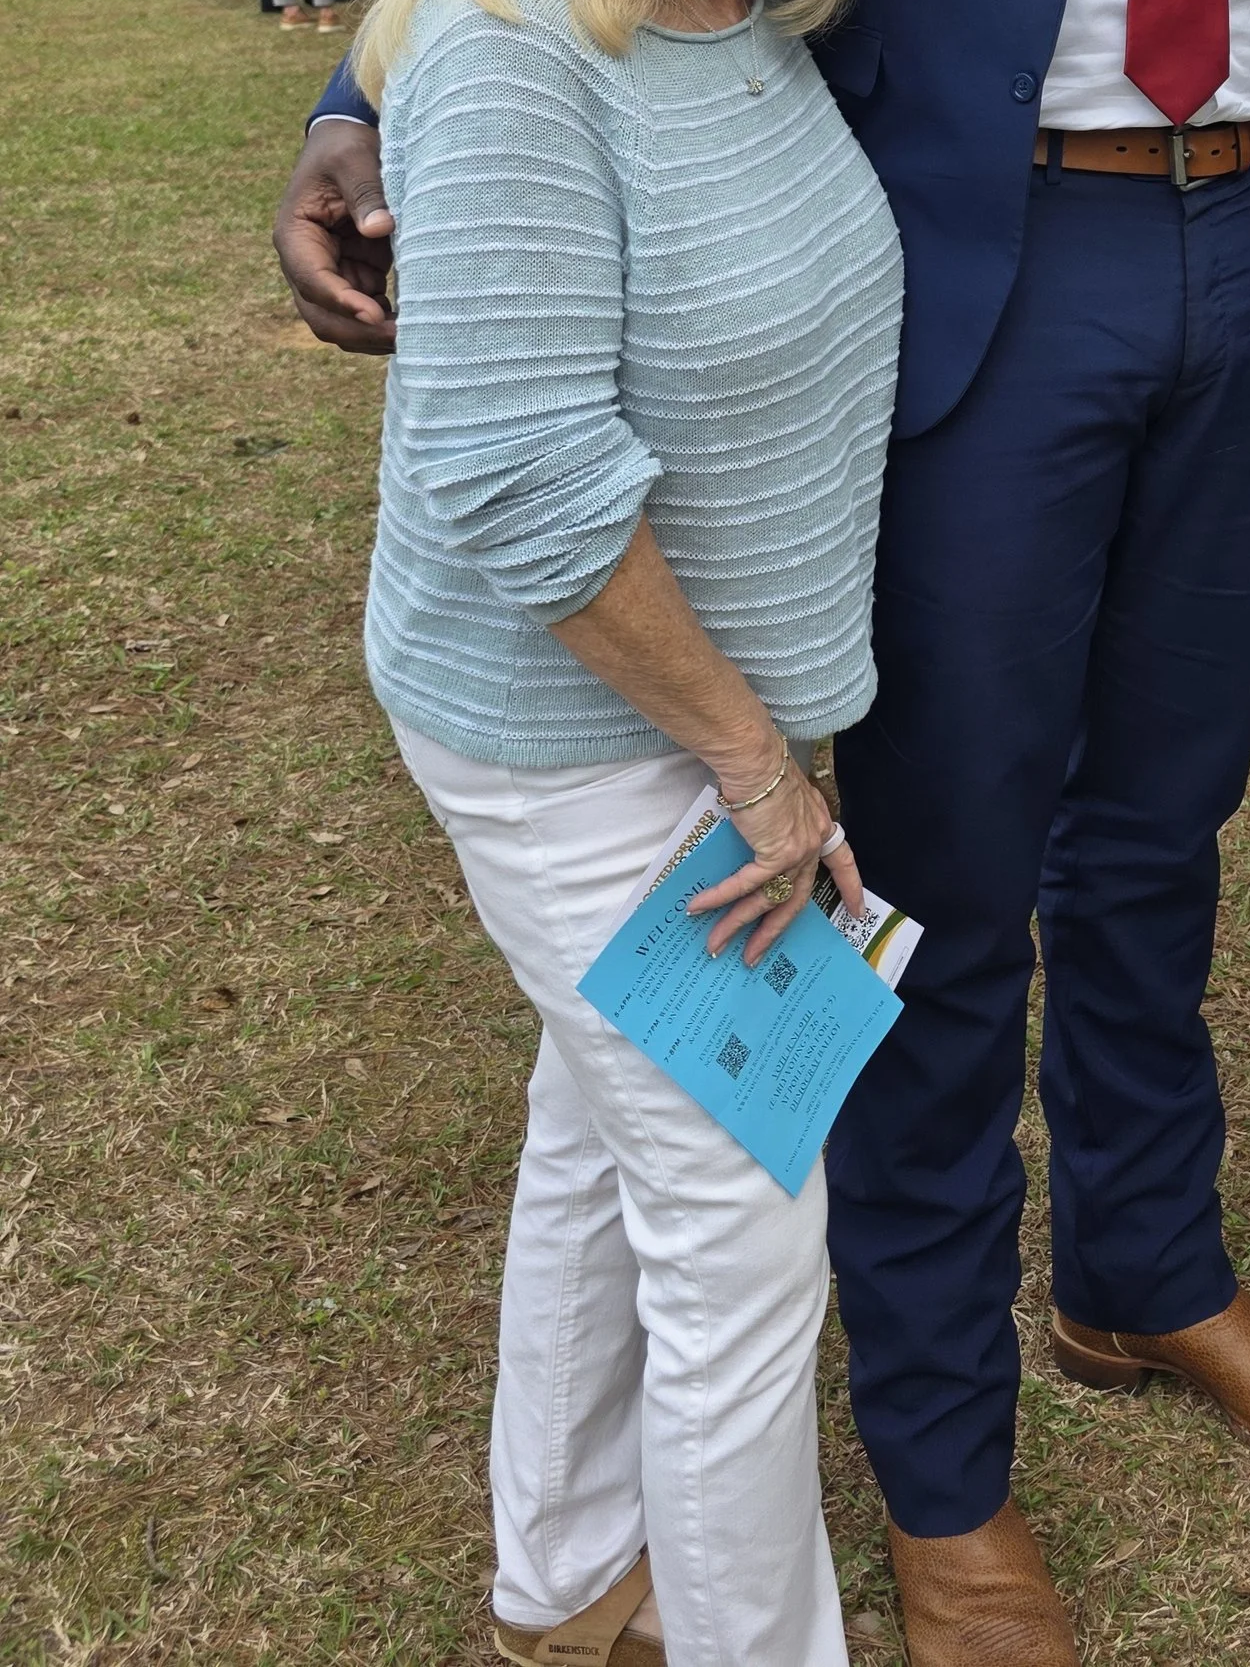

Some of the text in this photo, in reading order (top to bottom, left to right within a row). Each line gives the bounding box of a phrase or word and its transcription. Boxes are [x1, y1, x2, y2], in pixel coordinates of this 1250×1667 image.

[634, 876, 710, 958] WELCOME
[613, 991, 632, 1018] 5-6PM
[630, 947, 663, 992] CANDIDATE
[637, 974, 655, 998] FROM
[642, 1018, 660, 1045] 6-7PM
[659, 977, 687, 1018] WELCOME
[684, 967, 694, 979] BY
[645, 965, 673, 1005] CAROLINA
[670, 940, 691, 966] SWEET
[663, 943, 740, 1063] 7-8PM CANDIDATES MINGLE FOR
[666, 953, 713, 1025] ON THEIR TOP PRIO
[687, 1035, 695, 1045] &
[692, 991, 721, 1037] QUESTIONS
[718, 971, 733, 993] WITH
[766, 1076, 787, 1111] (EARLY
[783, 1037, 807, 1077] VOTING
[770, 1008, 813, 1080] VOTE JUNE 9TH
[780, 1012, 835, 1107] AT POLLS ASK FOR A
[789, 1020, 842, 1113] DEMOCRAT BALLOT
[548, 1644, 600, 1656] BIRKENSTOCK
